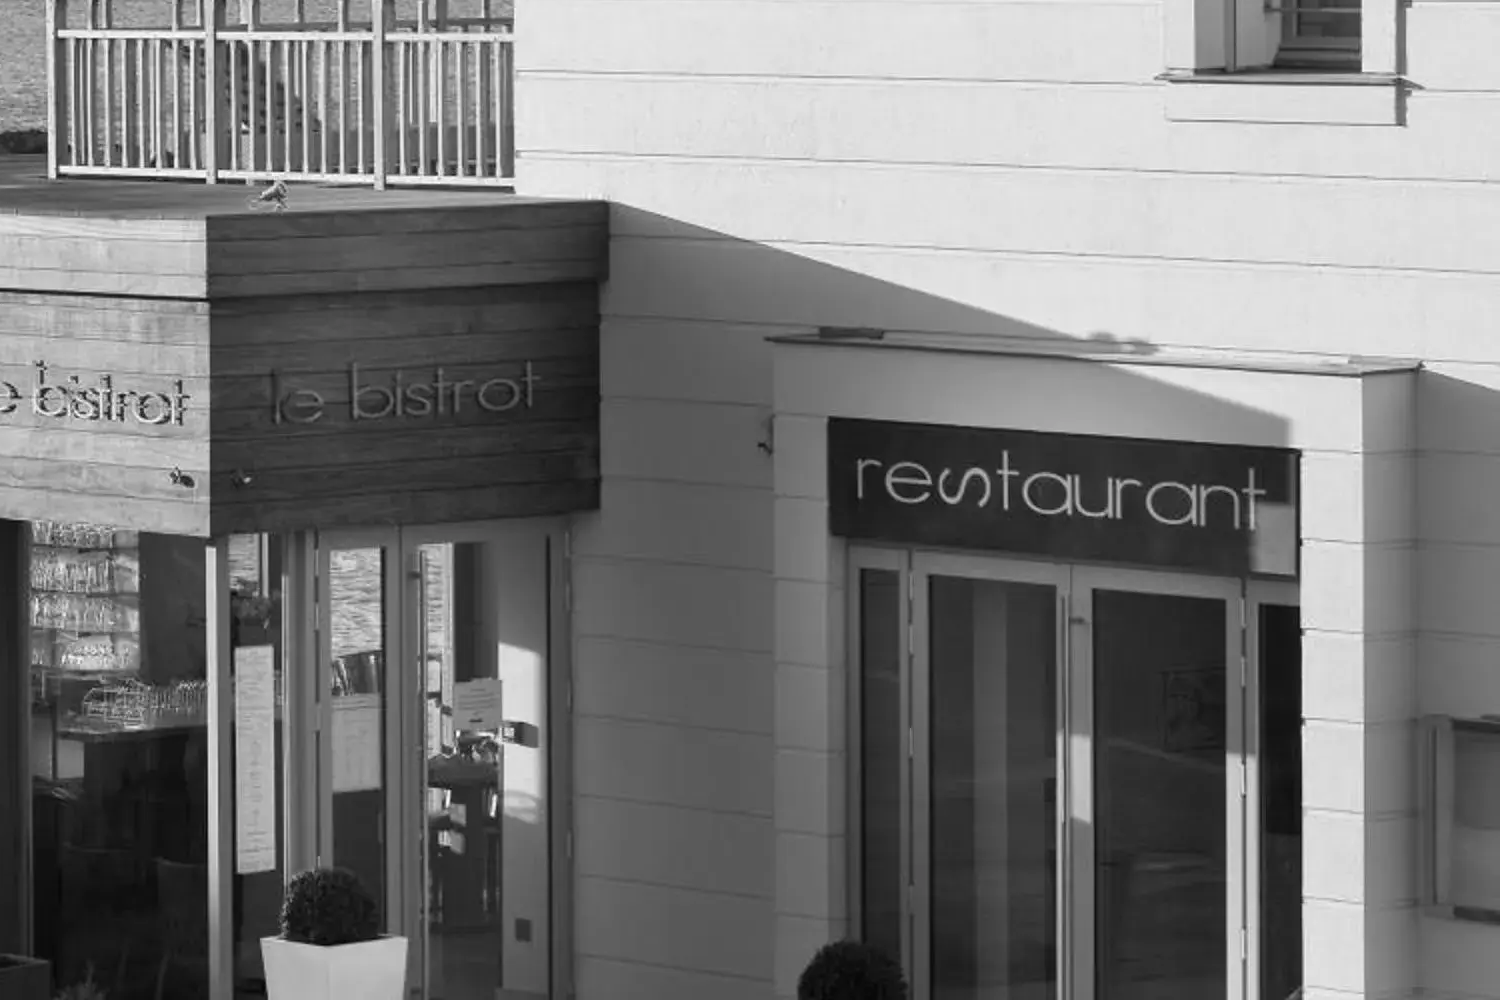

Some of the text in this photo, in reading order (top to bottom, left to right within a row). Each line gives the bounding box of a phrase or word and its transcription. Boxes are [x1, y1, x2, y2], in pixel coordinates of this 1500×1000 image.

[32, 360, 186, 426] bistrot
[271, 360, 542, 425] le bistrot
[856, 449, 1267, 531] restaurant
